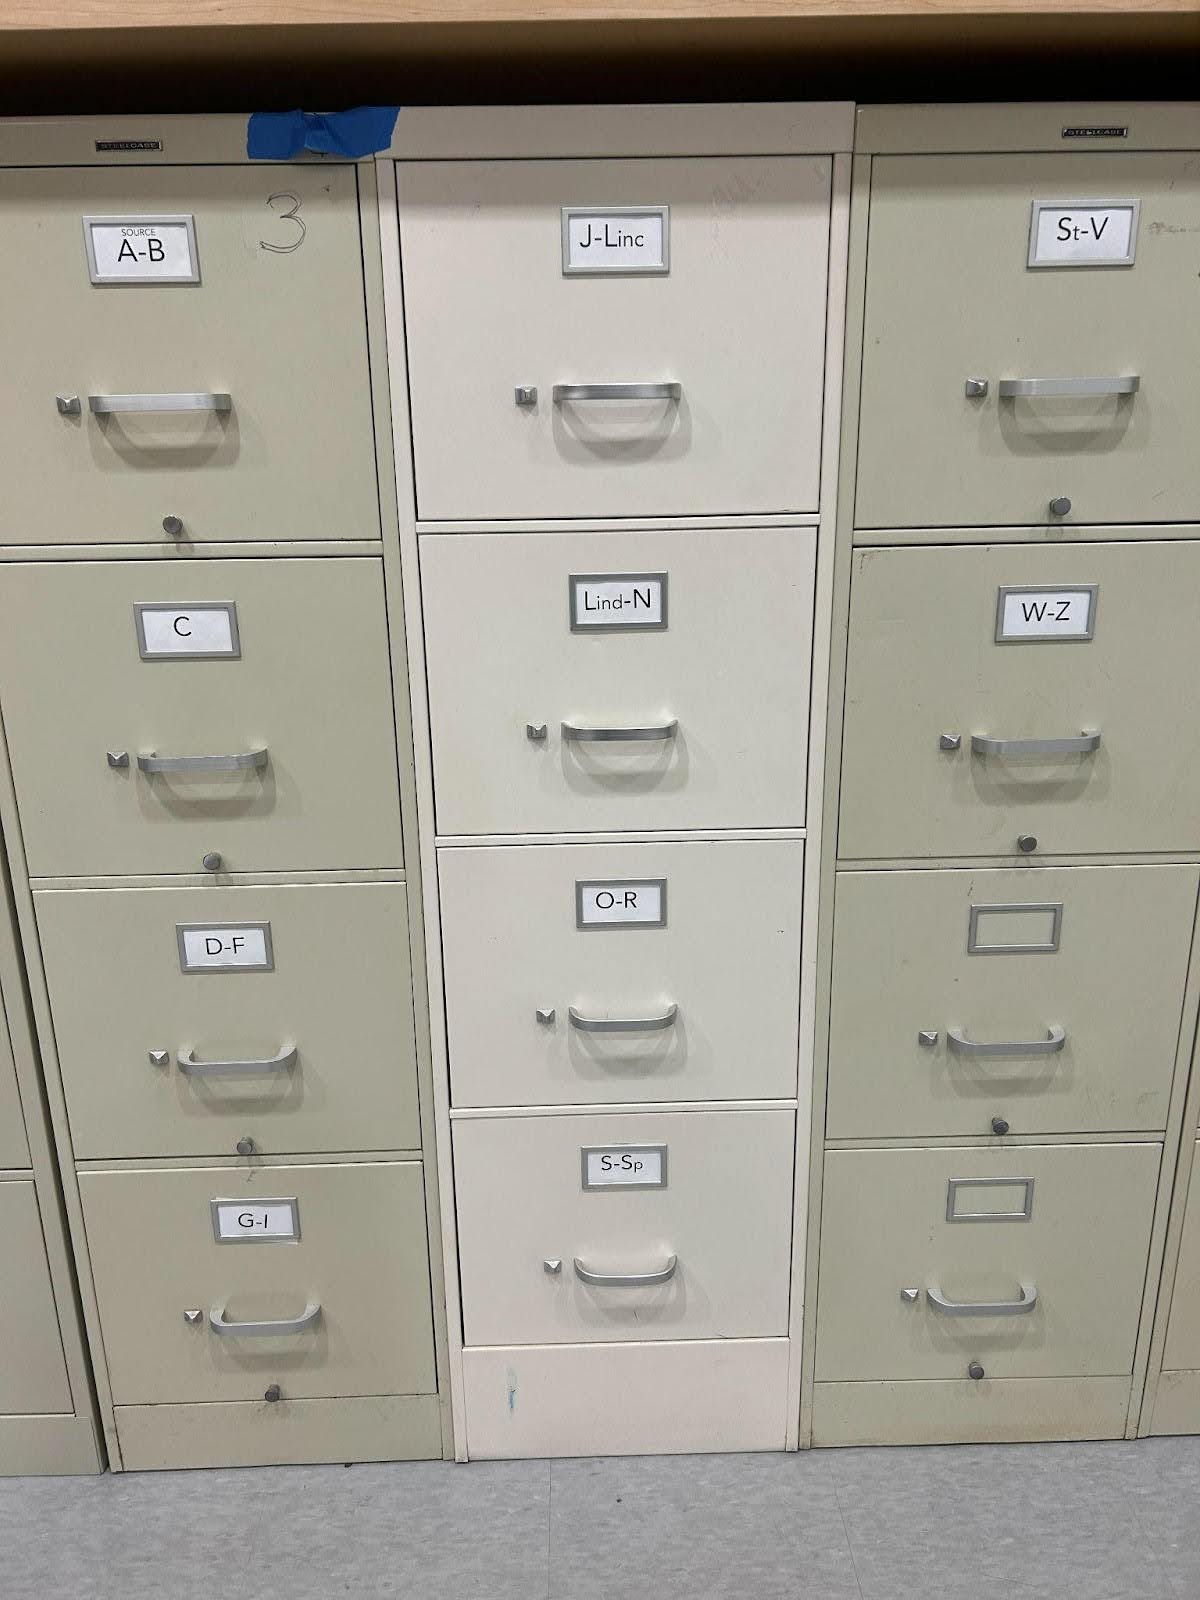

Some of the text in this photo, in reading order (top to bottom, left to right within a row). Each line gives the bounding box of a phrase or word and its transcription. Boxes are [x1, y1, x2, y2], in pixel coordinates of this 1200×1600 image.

[121, 228, 157, 237] SOURCE
[259, 192, 306, 254] 3
[1057, 216, 1110, 242] St-V
[580, 223, 644, 249] J-Linc
[117, 238, 166, 263] A-B
[584, 587, 651, 611] Lind-N
[1022, 601, 1072, 623] W-Z
[173, 615, 192, 637] C
[595, 891, 638, 910] O-R
[205, 936, 246, 956] D-F
[600, 1154, 644, 1174] S-Sp
[237, 1212, 269, 1229] G-I
